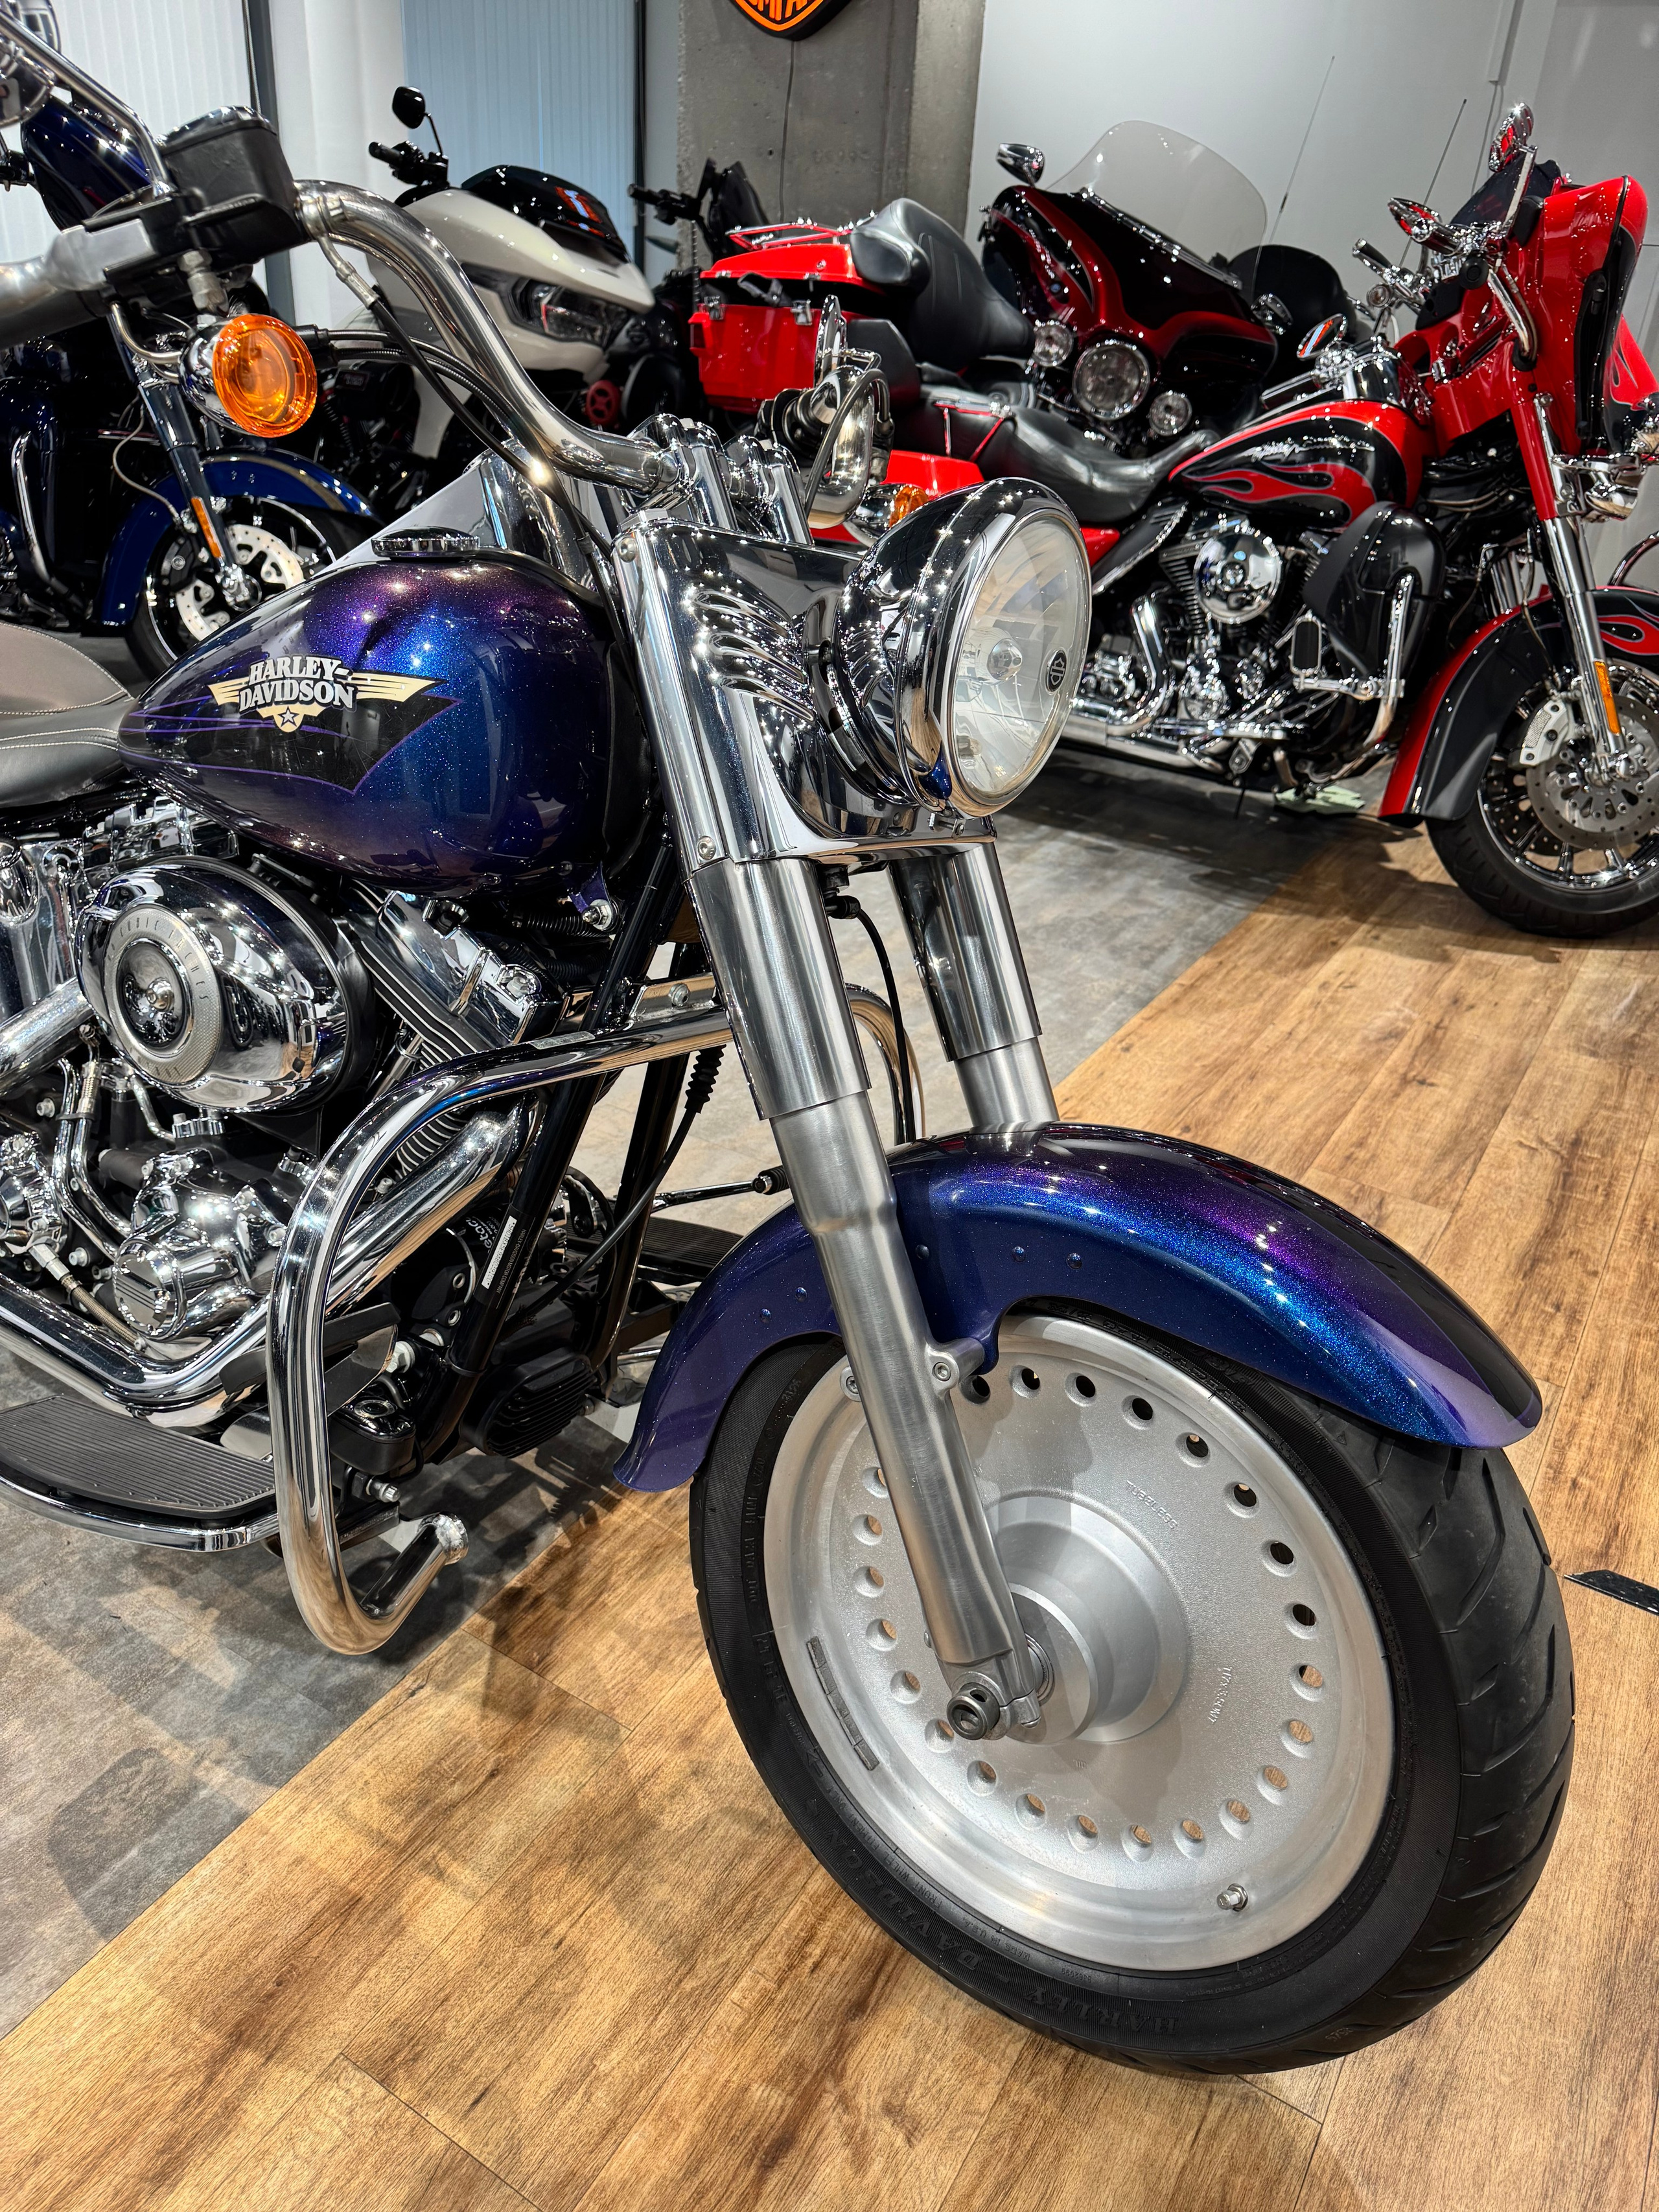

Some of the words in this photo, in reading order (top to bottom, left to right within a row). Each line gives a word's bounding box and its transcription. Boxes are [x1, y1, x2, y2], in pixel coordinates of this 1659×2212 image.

[249, 656, 350, 686] HARLEY-
[238, 678, 354, 712] DAVIDSON
[168, 929, 209, 1000] INCHES
[1126, 1480, 1178, 1530] TUBELESS
[824, 1784, 847, 1810] ONLY
[844, 1811, 881, 1852] FITMENT
[878, 1849, 911, 1882] WHEEL
[816, 1822, 984, 1974] DAVIDSON
[911, 1879, 944, 1909] FRONT
[989, 1933, 1001, 1948] IN
[1003, 1941, 1031, 1962] MADE
[1021, 1981, 1183, 2035] HARLEY
